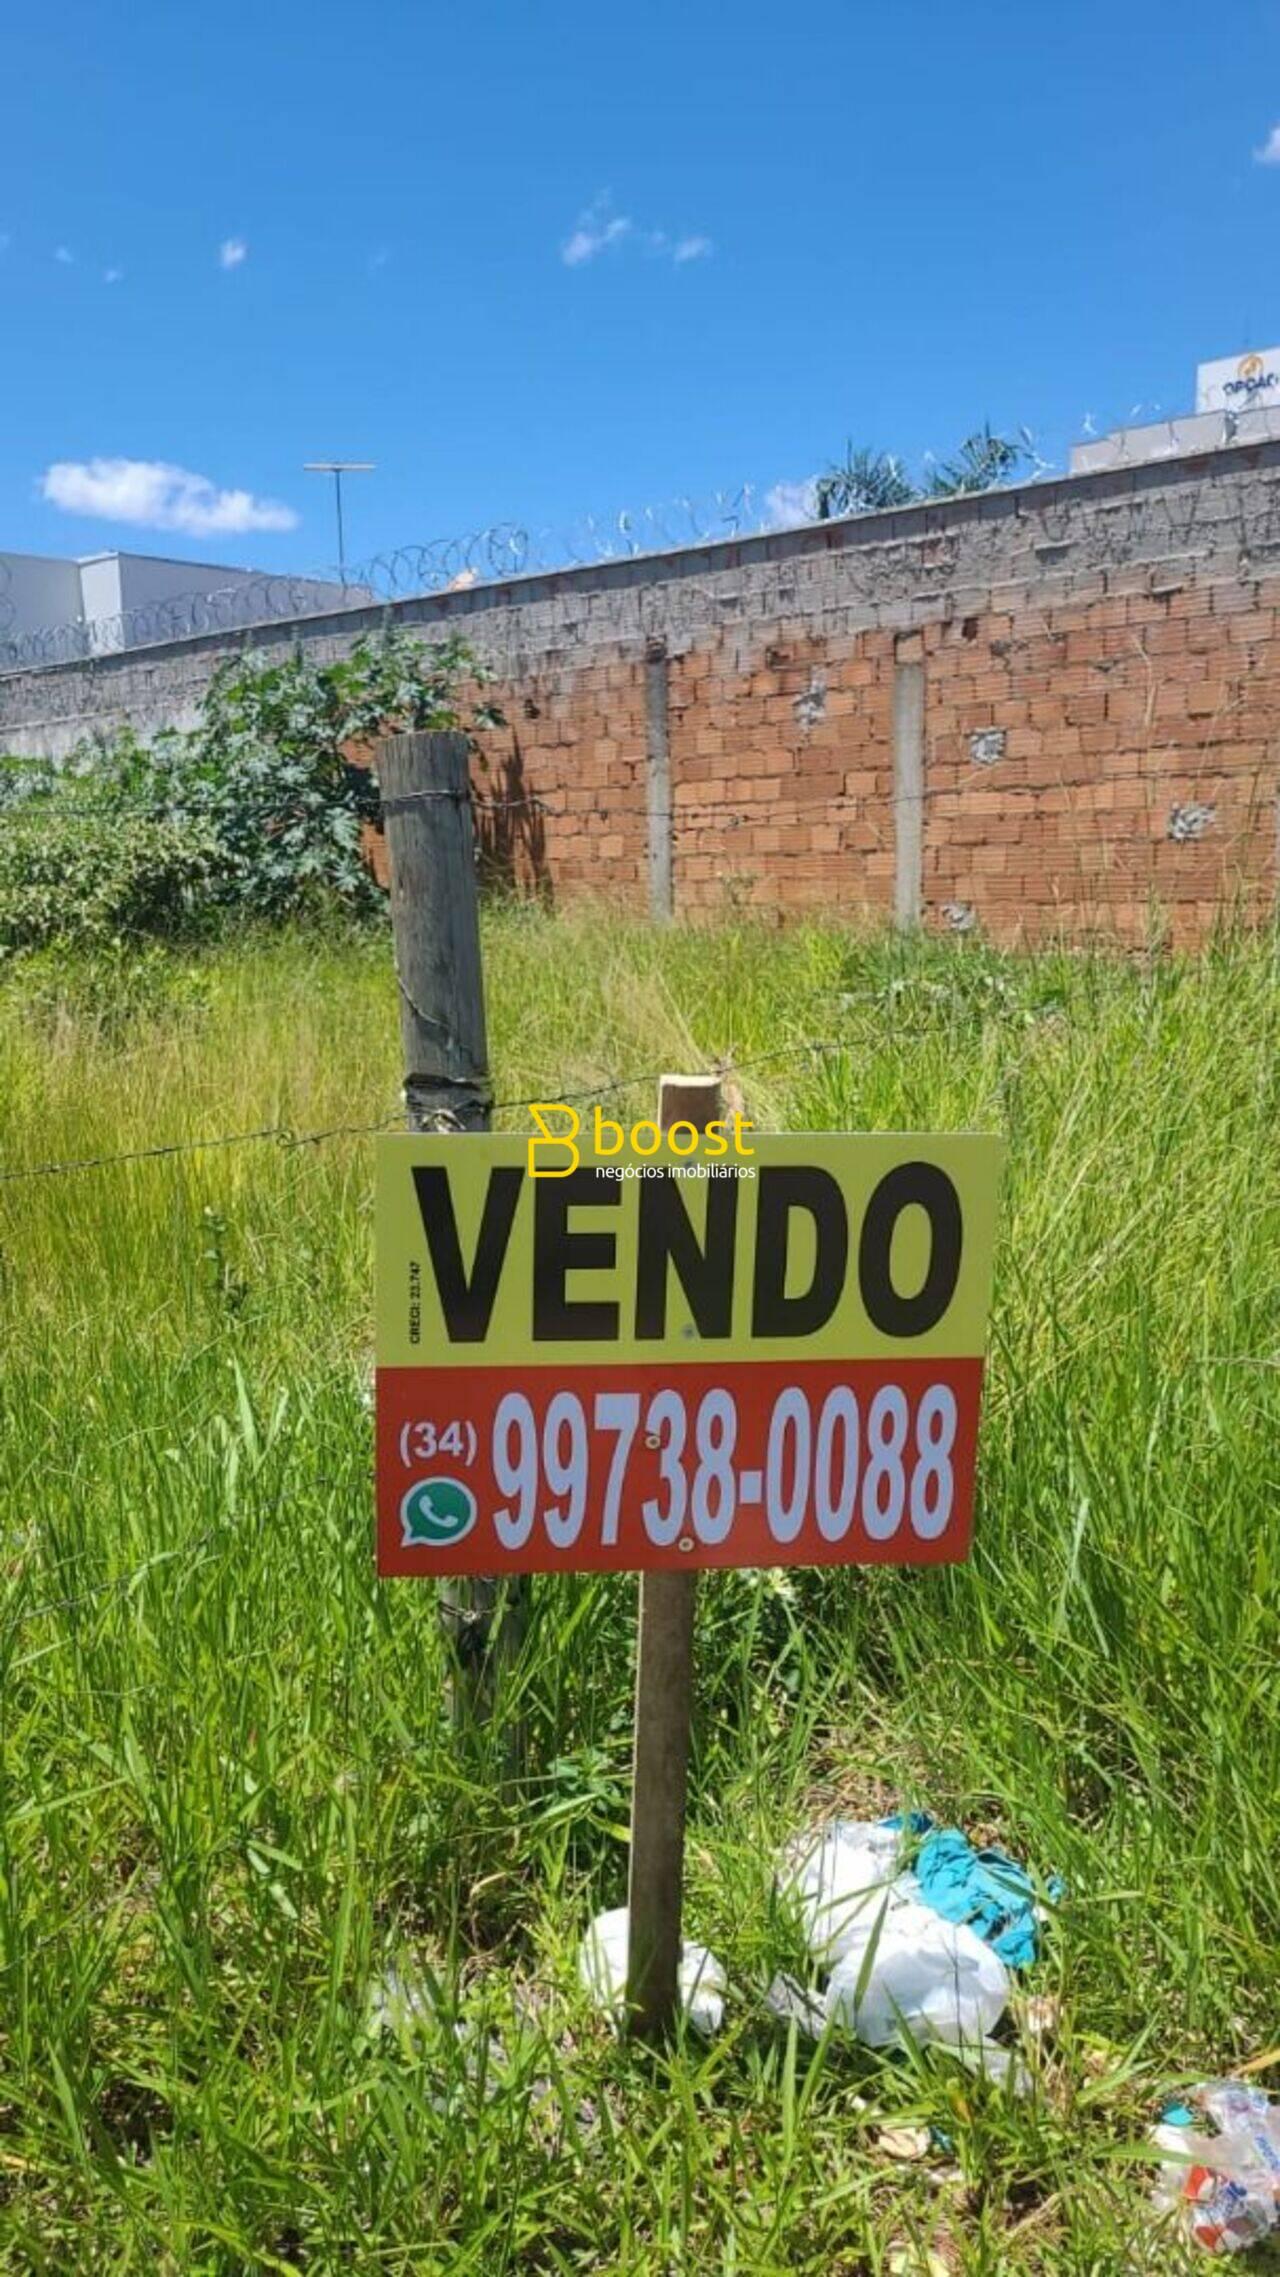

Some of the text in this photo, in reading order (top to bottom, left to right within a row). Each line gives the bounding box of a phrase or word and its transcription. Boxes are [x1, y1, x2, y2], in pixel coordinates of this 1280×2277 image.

[411, 1161, 963, 1343] VENDO
[399, 1384, 958, 1550] (34) 99738-0088
